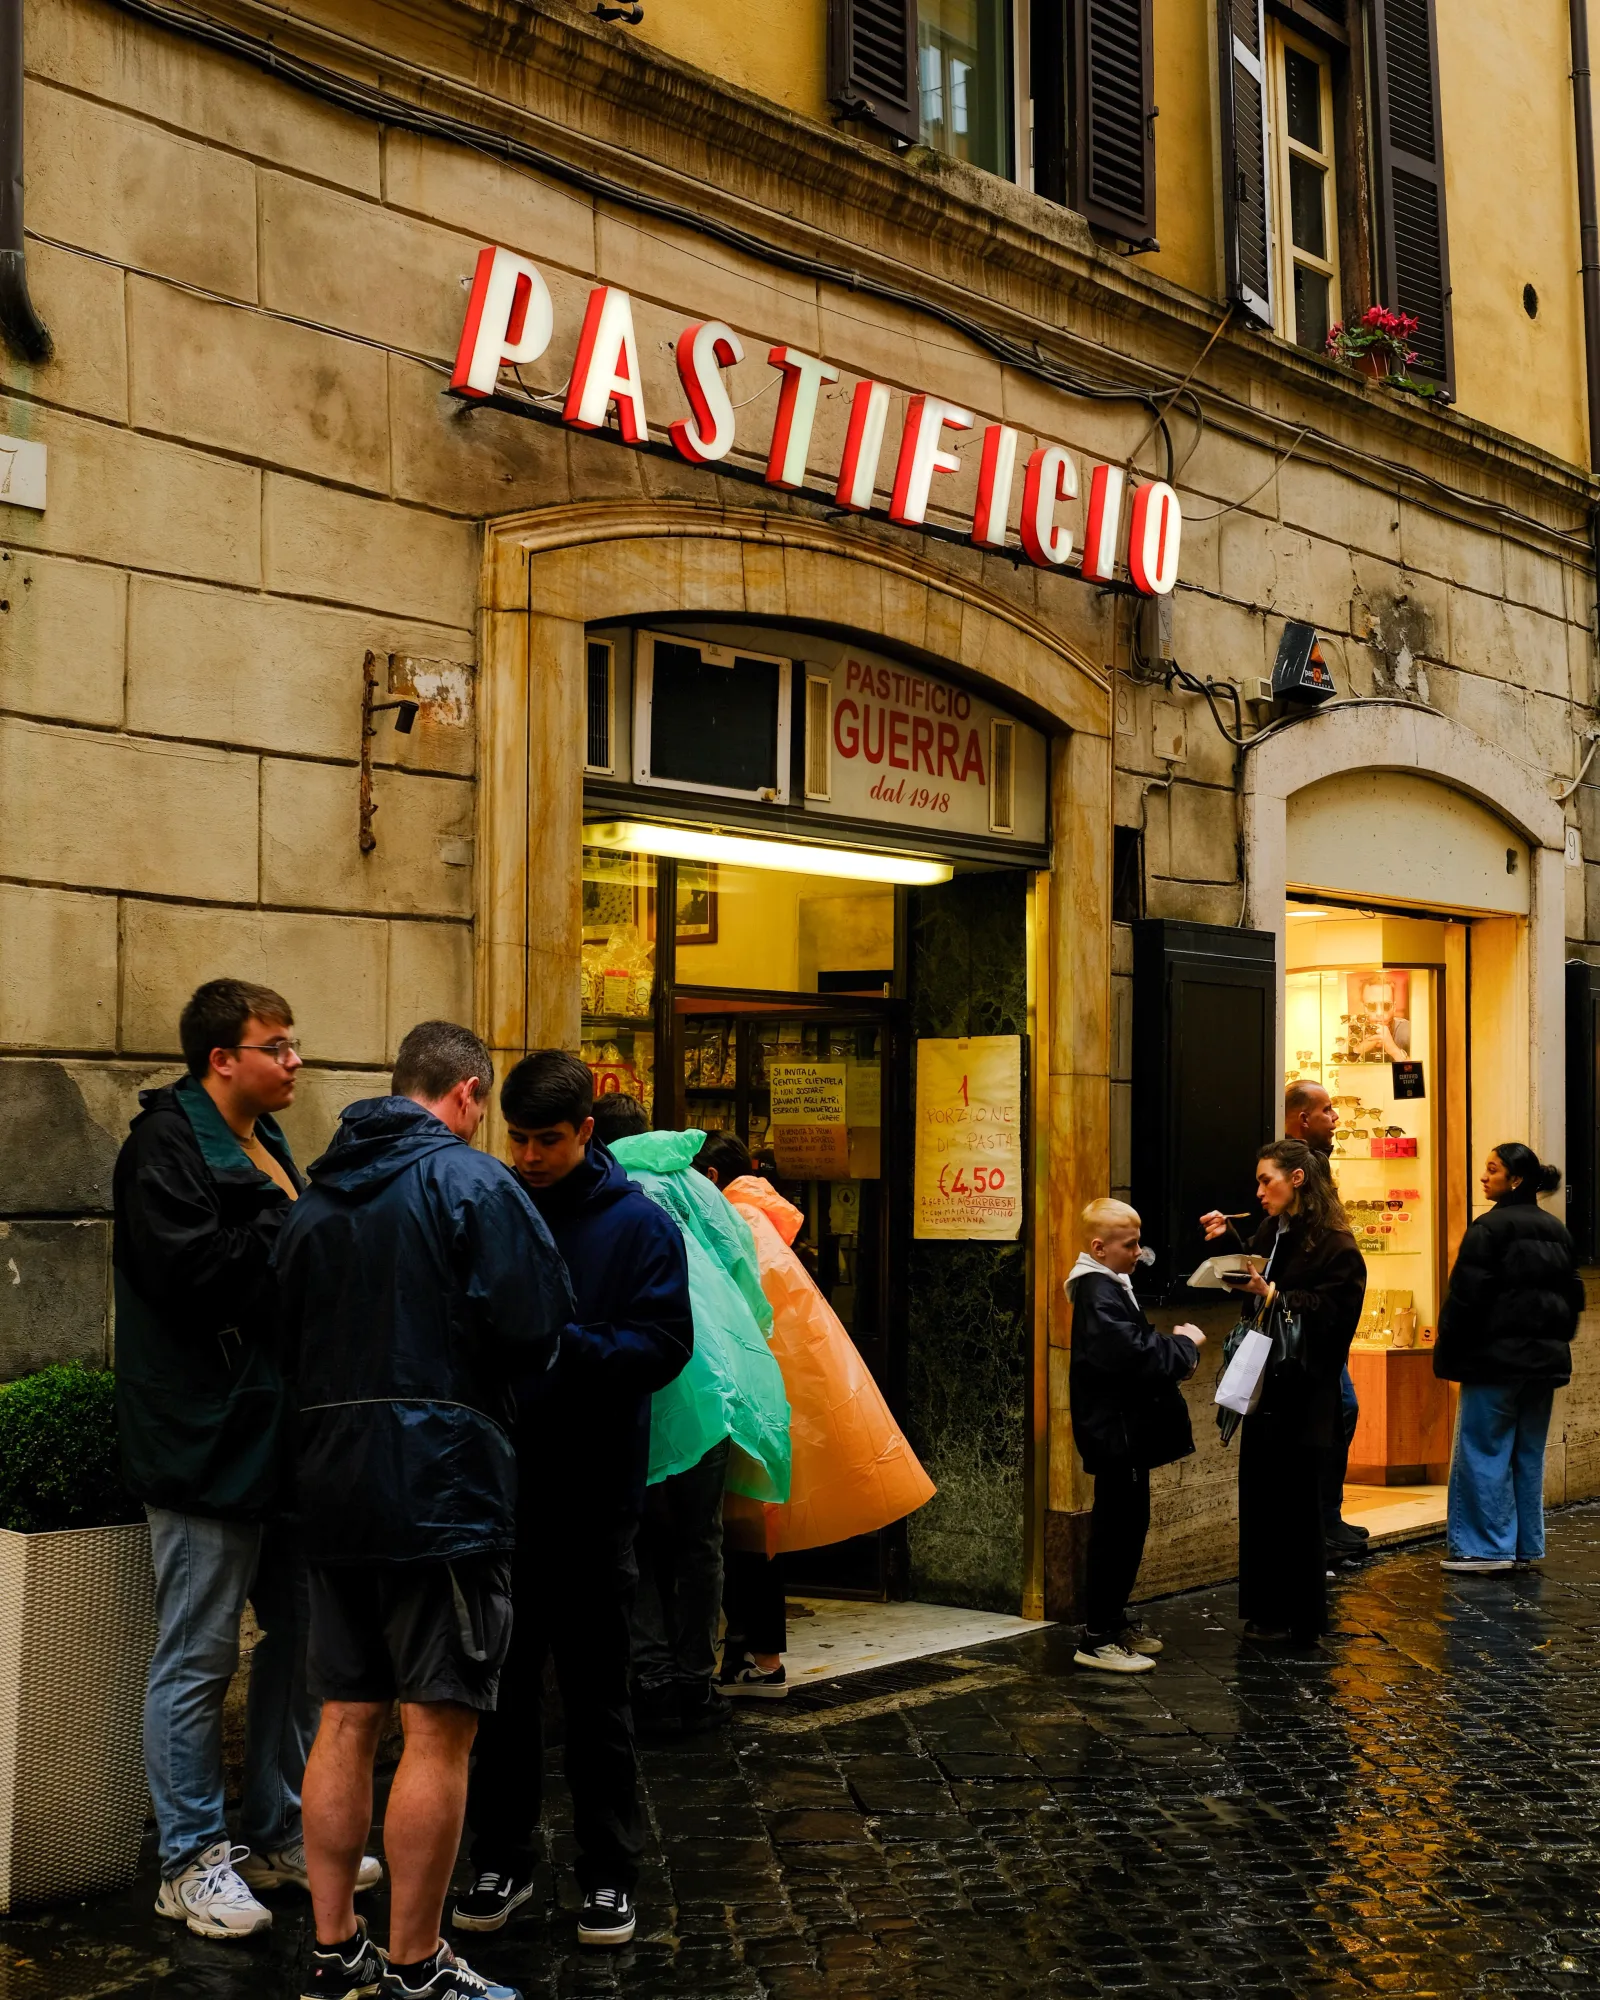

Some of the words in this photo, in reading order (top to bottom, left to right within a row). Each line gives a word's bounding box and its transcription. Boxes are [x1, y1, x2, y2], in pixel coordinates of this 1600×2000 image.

[449, 245, 1181, 596] PASTIFICIO
[846, 659, 971, 721] PASTIFICIO
[833, 698, 986, 786] GUERRA
[870, 775, 905, 804] dal
[908, 787, 951, 813] 1918
[1568, 831, 1576, 861] 9
[773, 1067, 780, 1077] SI
[808, 1068, 817, 1076] LA
[773, 1077, 802, 1087] GENTILE
[957, 1074, 969, 1107] 1
[927, 1106, 1013, 1124] PORZIONE
[937, 1138, 949, 1152] DI
[967, 1132, 1013, 1150] PASTA
[937, 1162, 1005, 1199] €4,50
